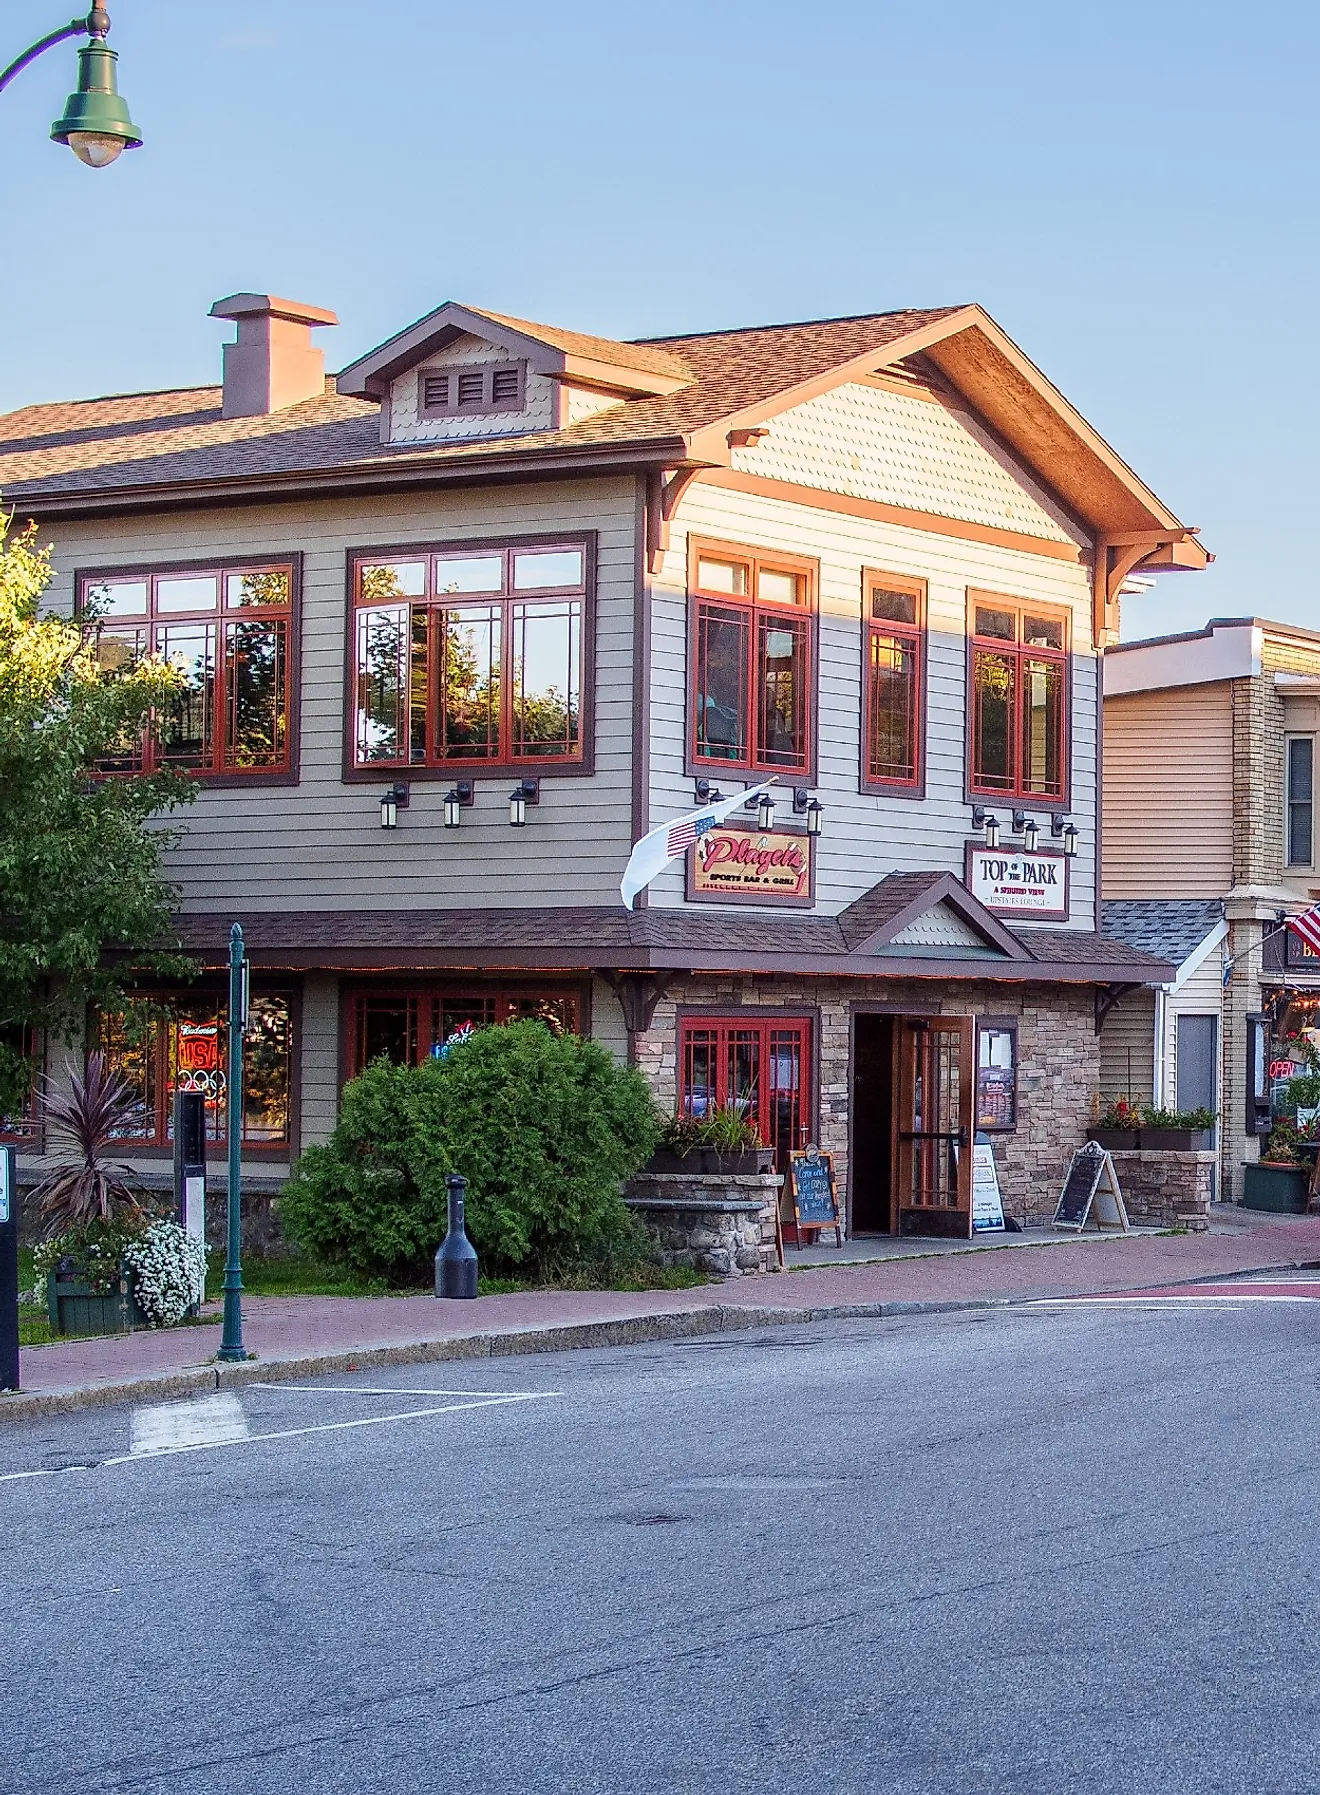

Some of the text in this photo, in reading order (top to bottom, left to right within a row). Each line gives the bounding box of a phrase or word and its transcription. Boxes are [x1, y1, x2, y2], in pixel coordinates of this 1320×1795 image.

[710, 873, 741, 882] SPORTS
[744, 875, 760, 883] BAR
[772, 877, 794, 885] GRILL
[980, 859, 1057, 885] TOP OF THE PARK
[994, 886, 999, 894] A
[1028, 888, 1045, 896] VIEW
[179, 1042, 224, 1069] USA
[1270, 1061, 1295, 1077] OPEN
